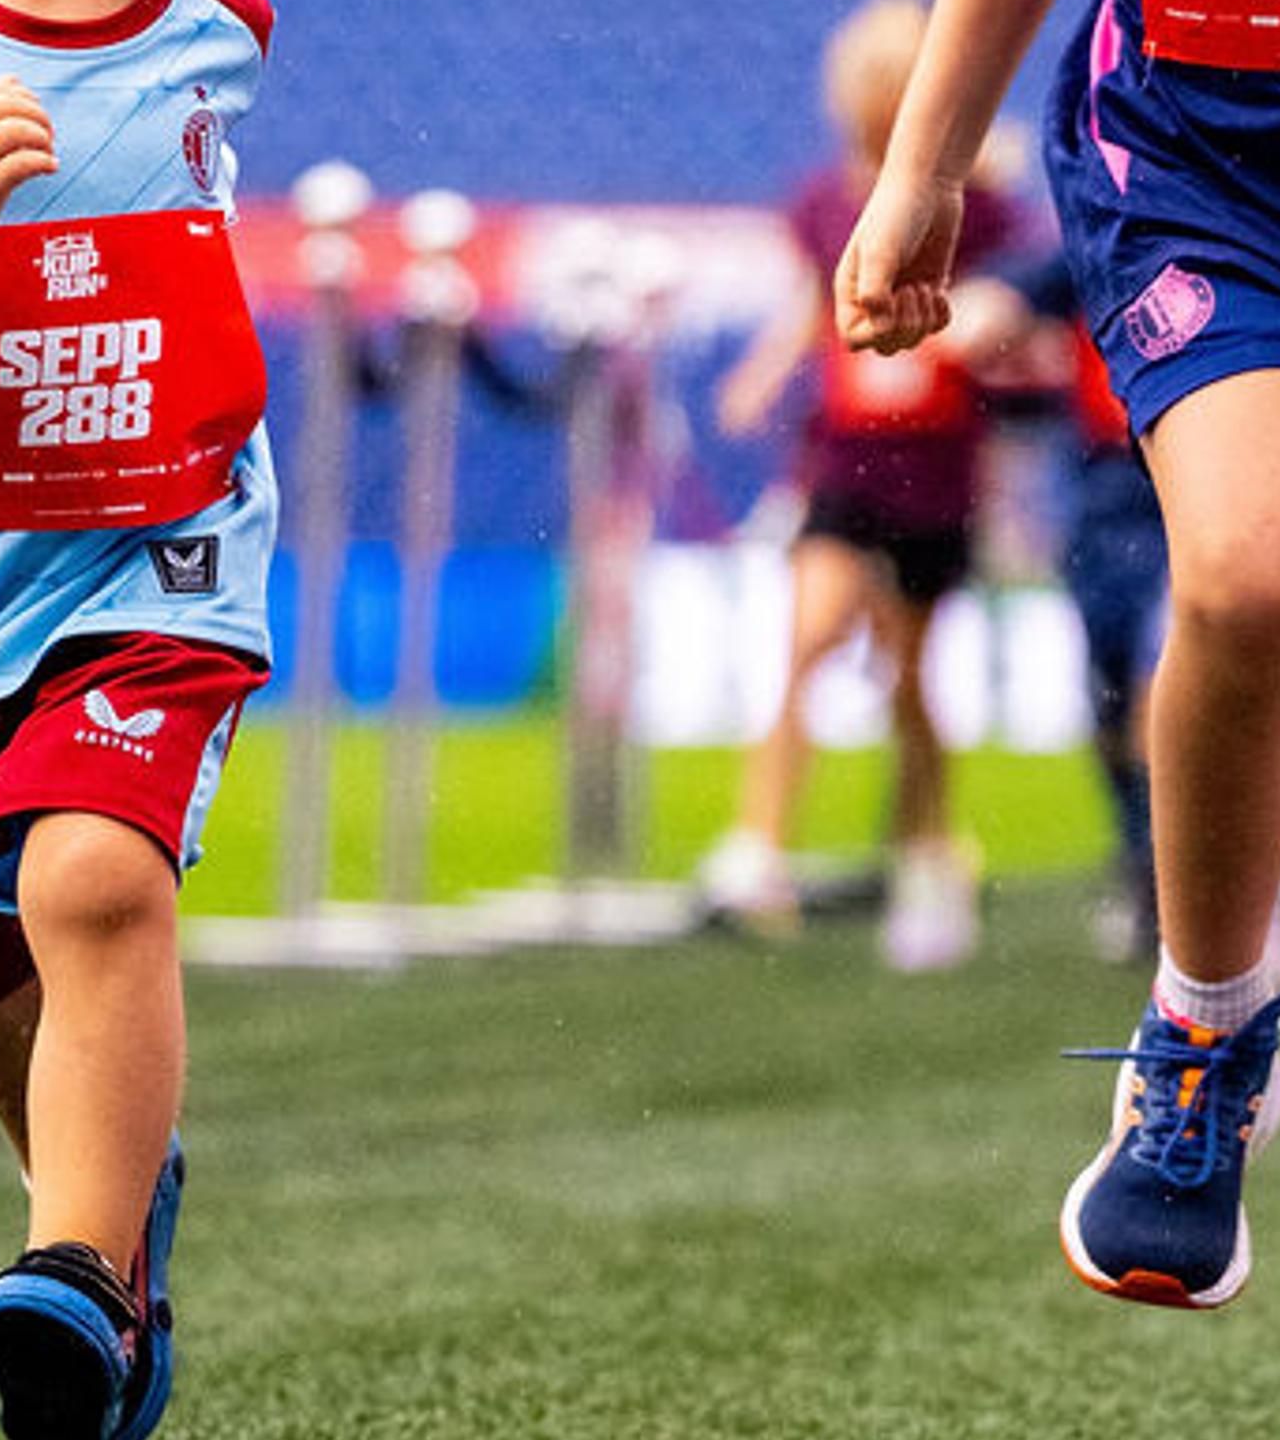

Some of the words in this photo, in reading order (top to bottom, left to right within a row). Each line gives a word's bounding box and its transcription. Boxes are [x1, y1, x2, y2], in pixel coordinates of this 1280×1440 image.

[41, 250, 101, 278] KUIP
[47, 273, 98, 301] RUN
[18, 380, 153, 447] 288
